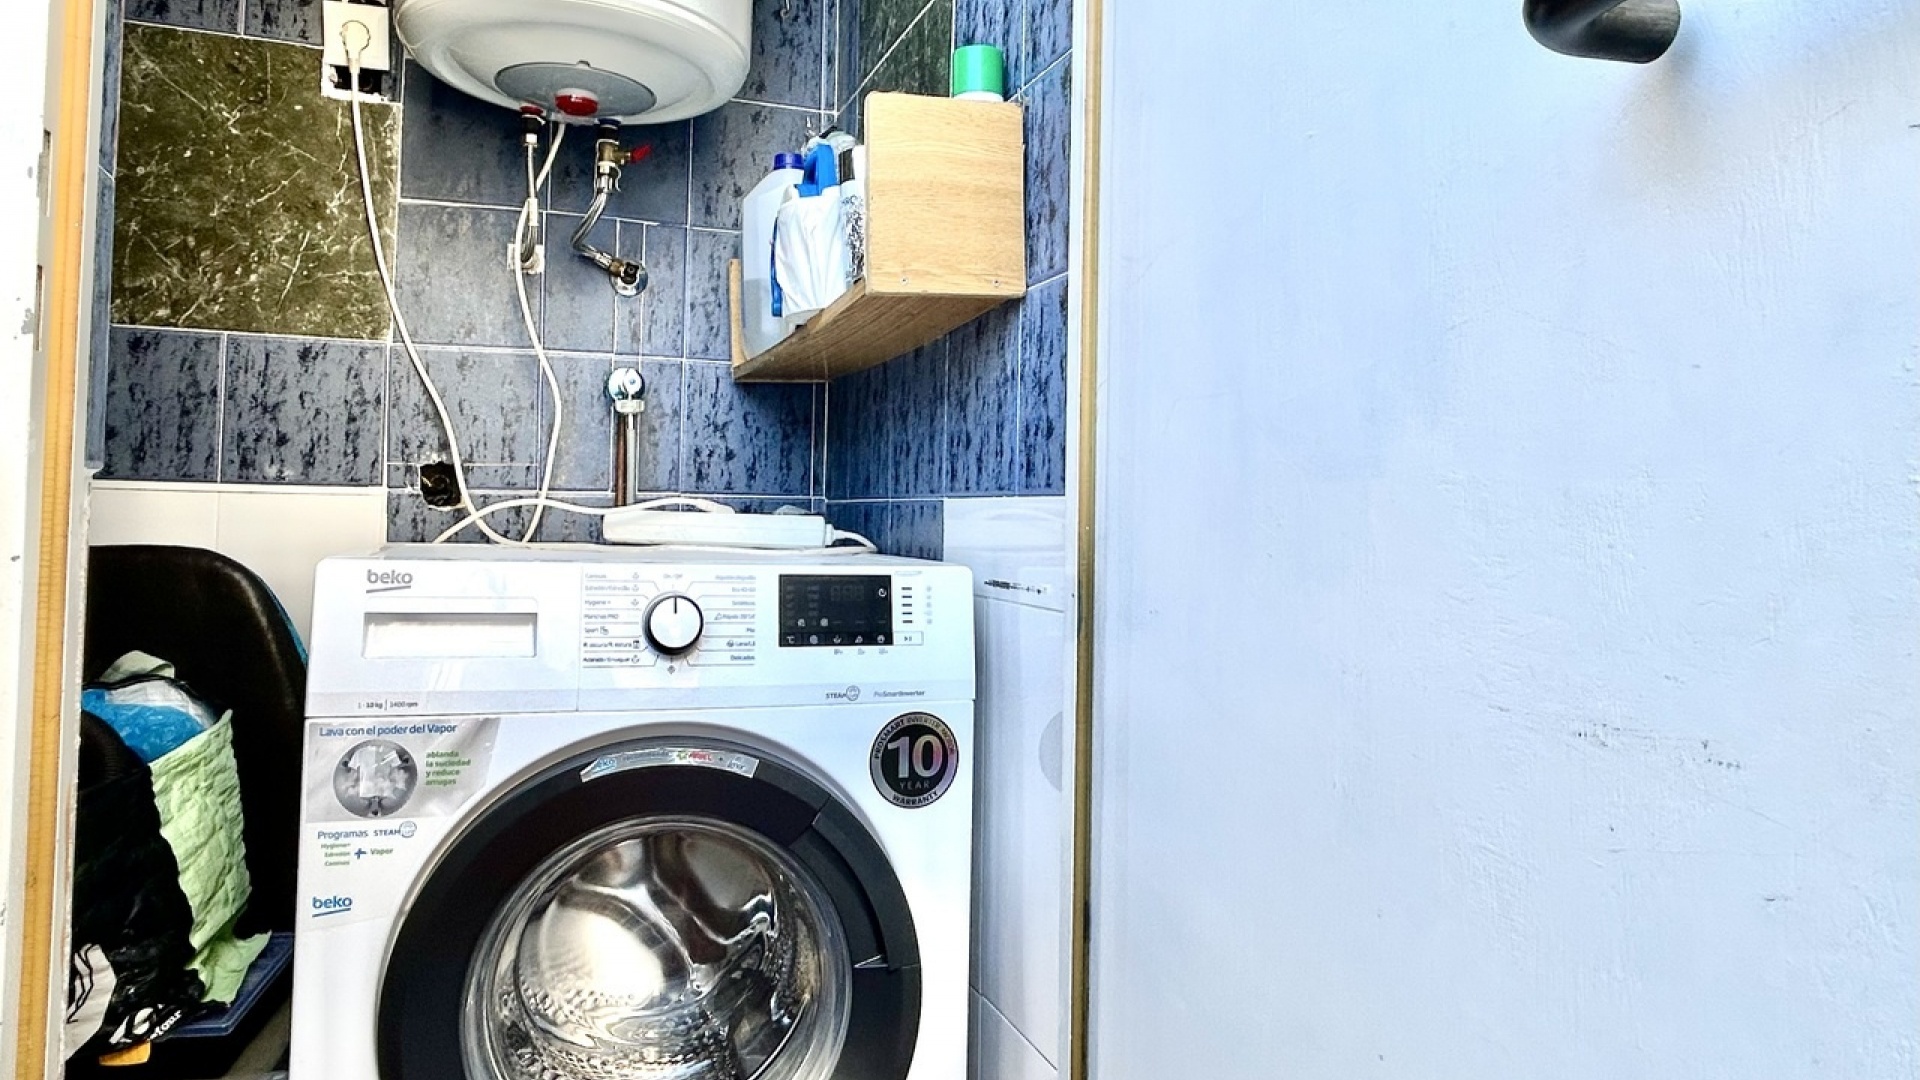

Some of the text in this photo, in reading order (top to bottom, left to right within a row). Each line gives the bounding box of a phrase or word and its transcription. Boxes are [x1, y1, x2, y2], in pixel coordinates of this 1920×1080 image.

[366, 569, 413, 584] beko
[319, 723, 458, 737] Lava con el poder del Vapor
[887, 734, 943, 779] 10
[899, 780, 930, 790] YEAR
[317, 829, 368, 840] Programas
[311, 895, 352, 909] beko
